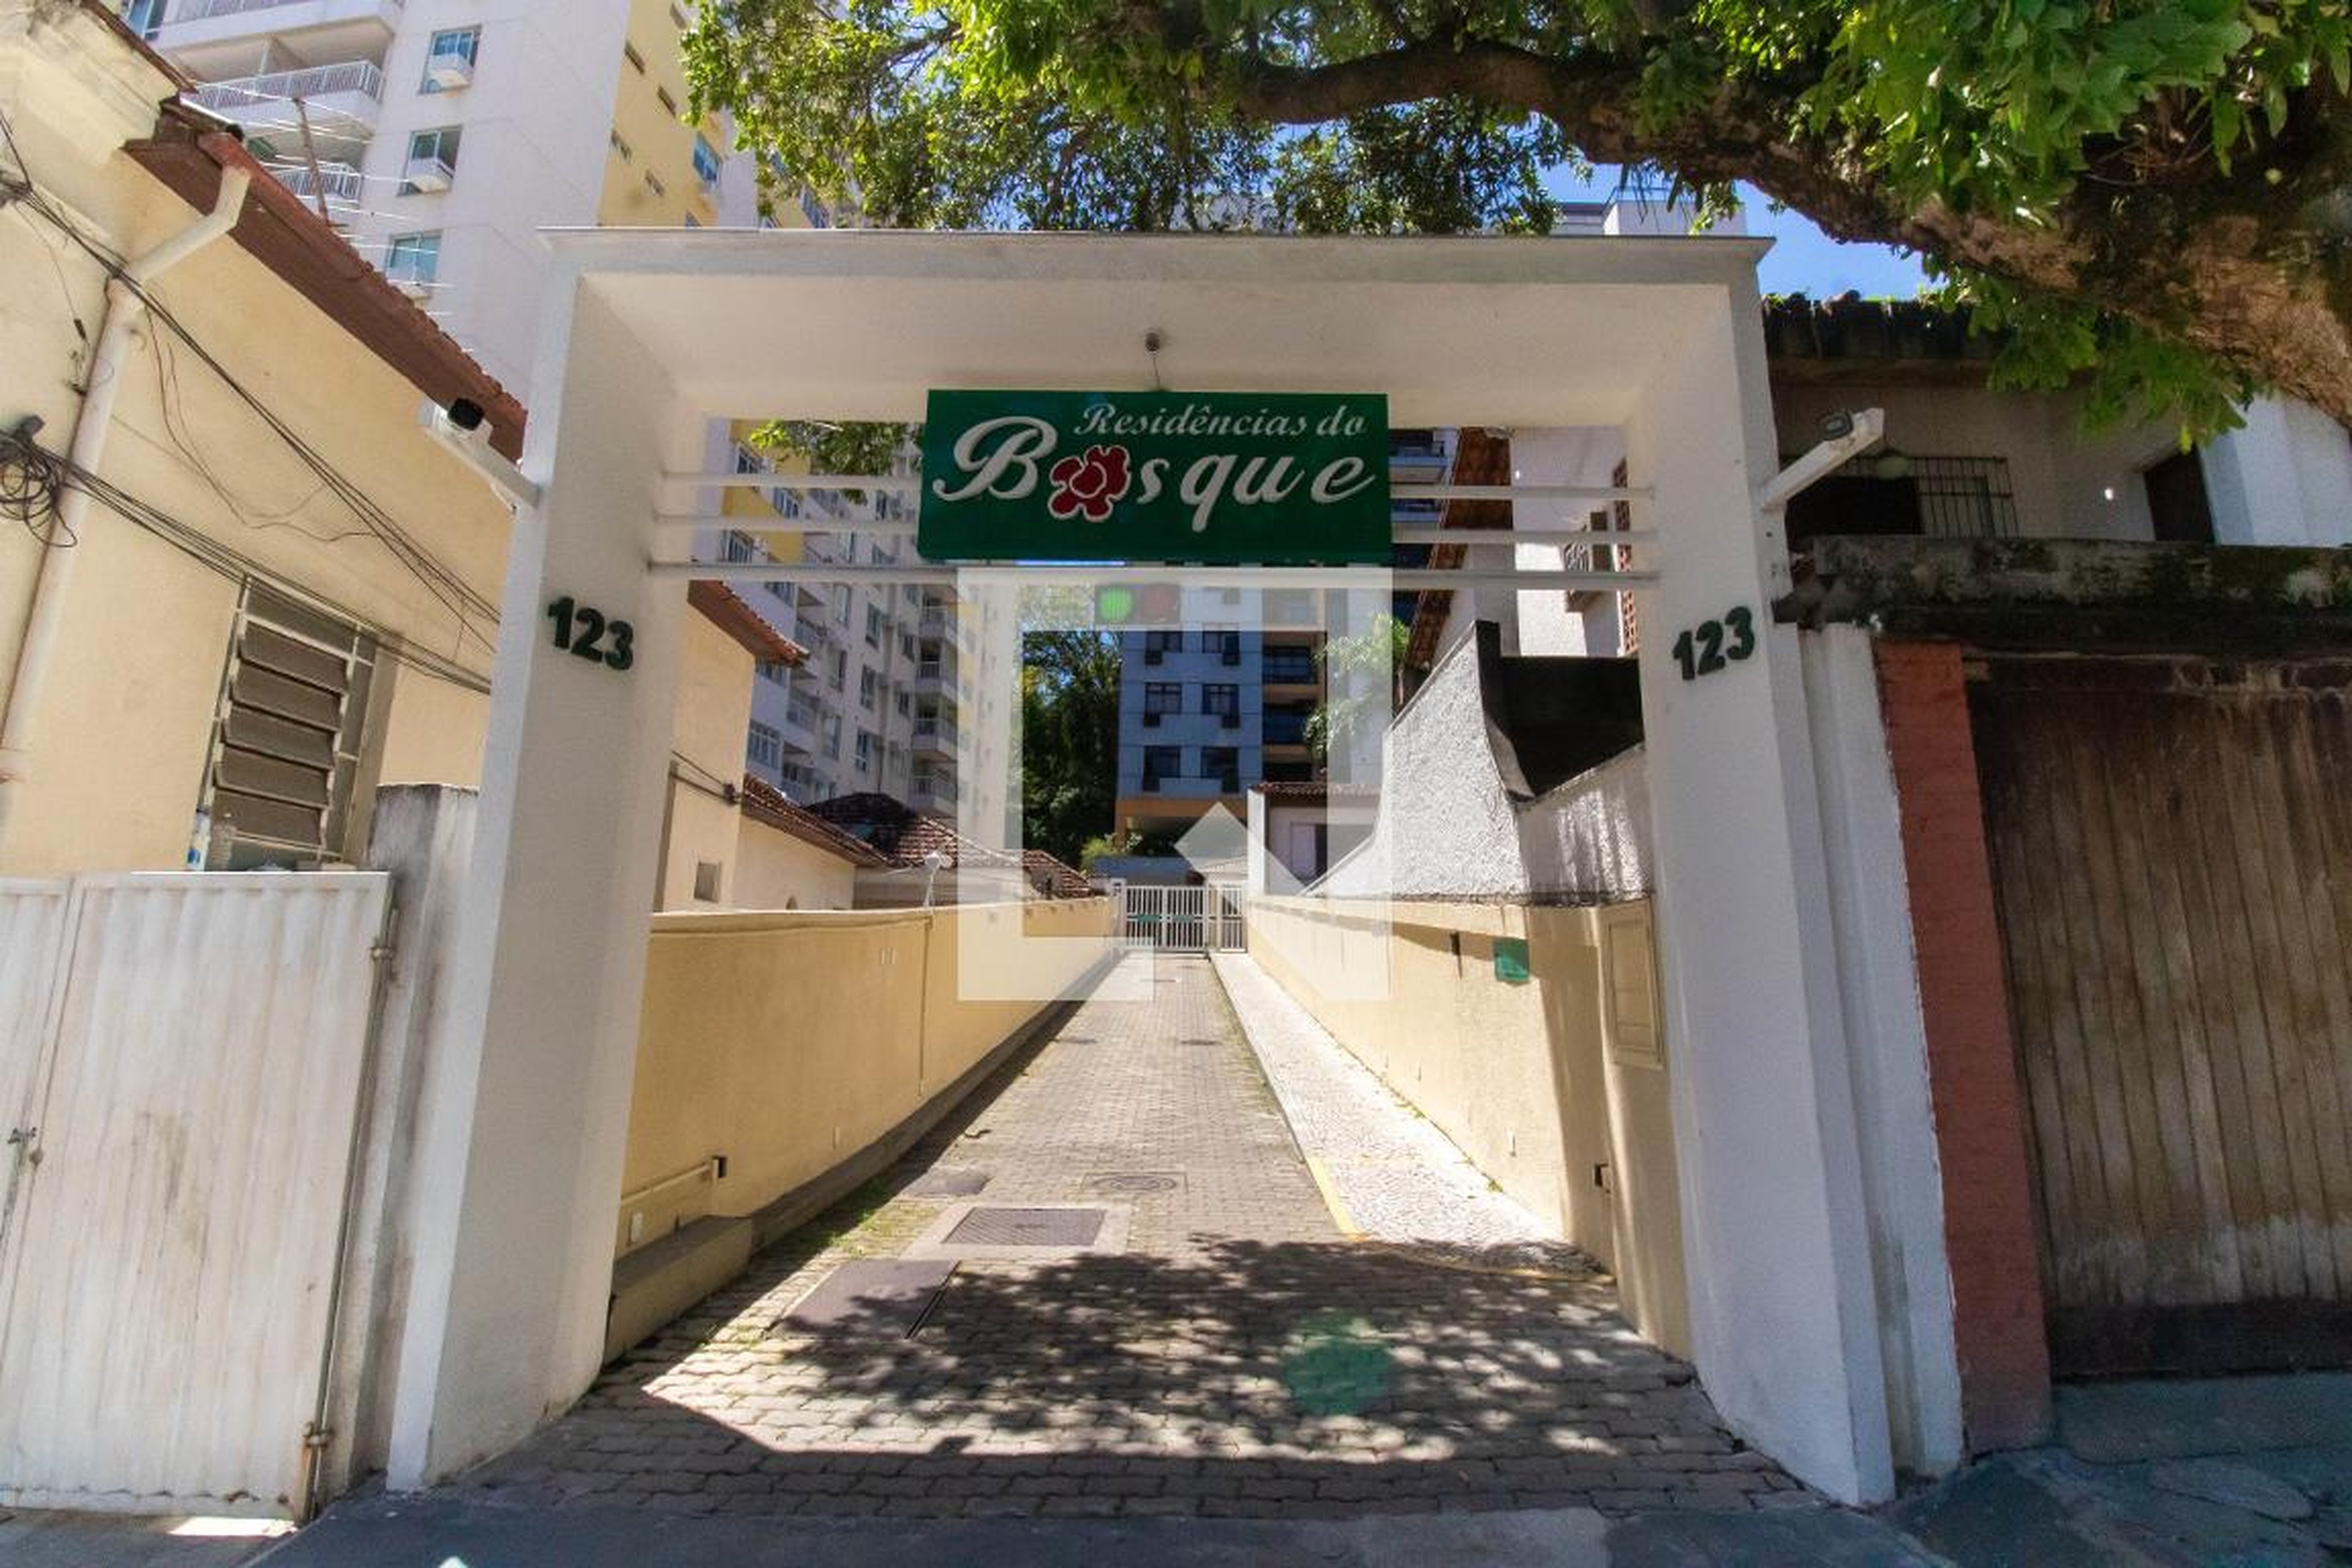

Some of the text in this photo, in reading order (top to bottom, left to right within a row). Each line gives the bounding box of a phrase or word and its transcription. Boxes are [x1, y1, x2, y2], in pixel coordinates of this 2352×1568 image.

[1074, 403, 1366, 436] Residências do
[548, 595, 633, 670] 123
[1672, 606, 1755, 680] 123
